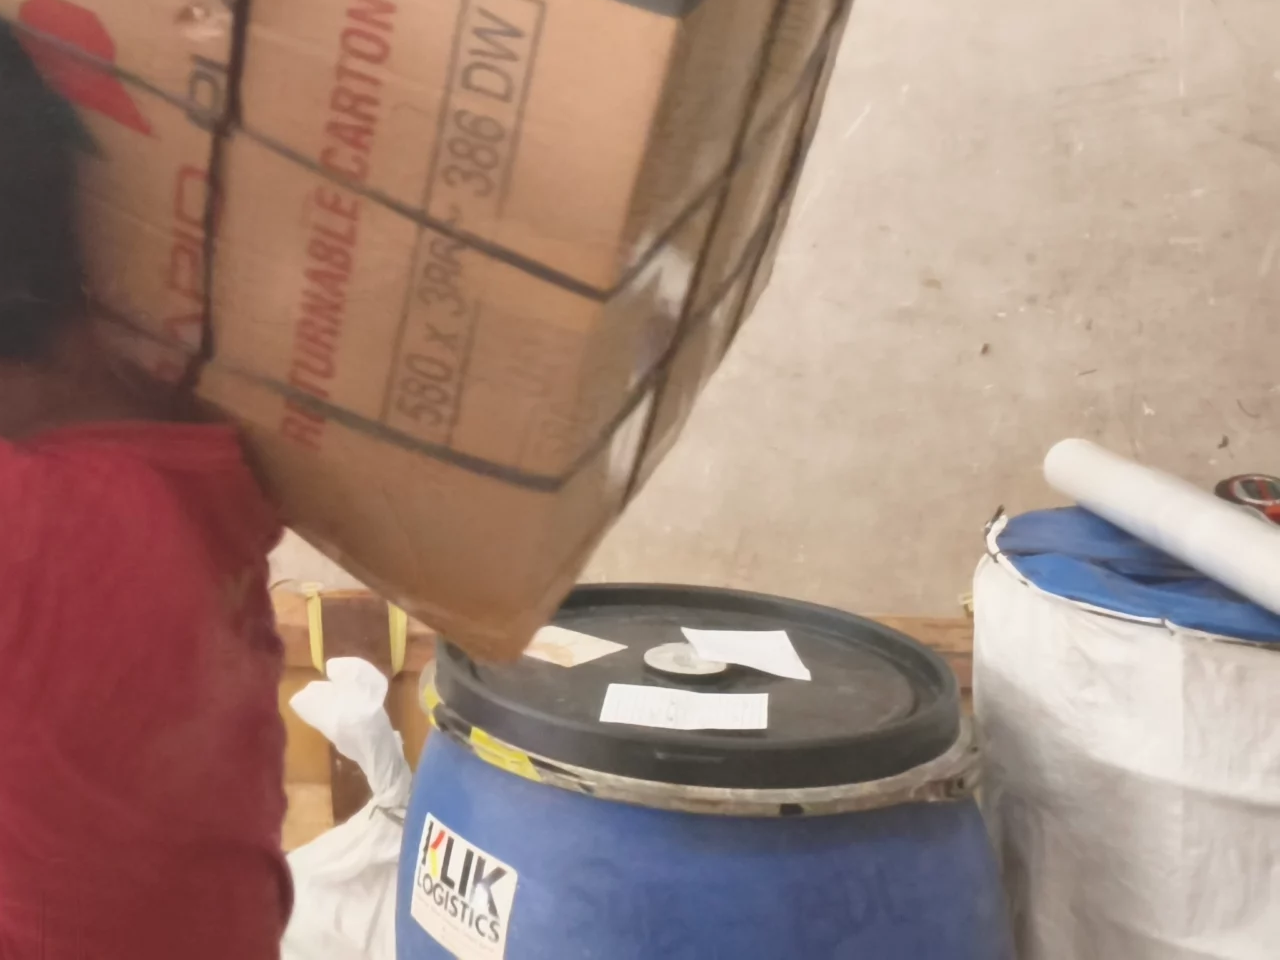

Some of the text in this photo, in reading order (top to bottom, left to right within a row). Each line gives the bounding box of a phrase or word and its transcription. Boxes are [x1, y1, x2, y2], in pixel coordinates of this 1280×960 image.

[460, 6, 527, 103] DW
[440, 110, 505, 197] 386
[394, 352, 453, 428] 580
[417, 865, 501, 944] LOGISTICS
[422, 822, 507, 918] KLIK
